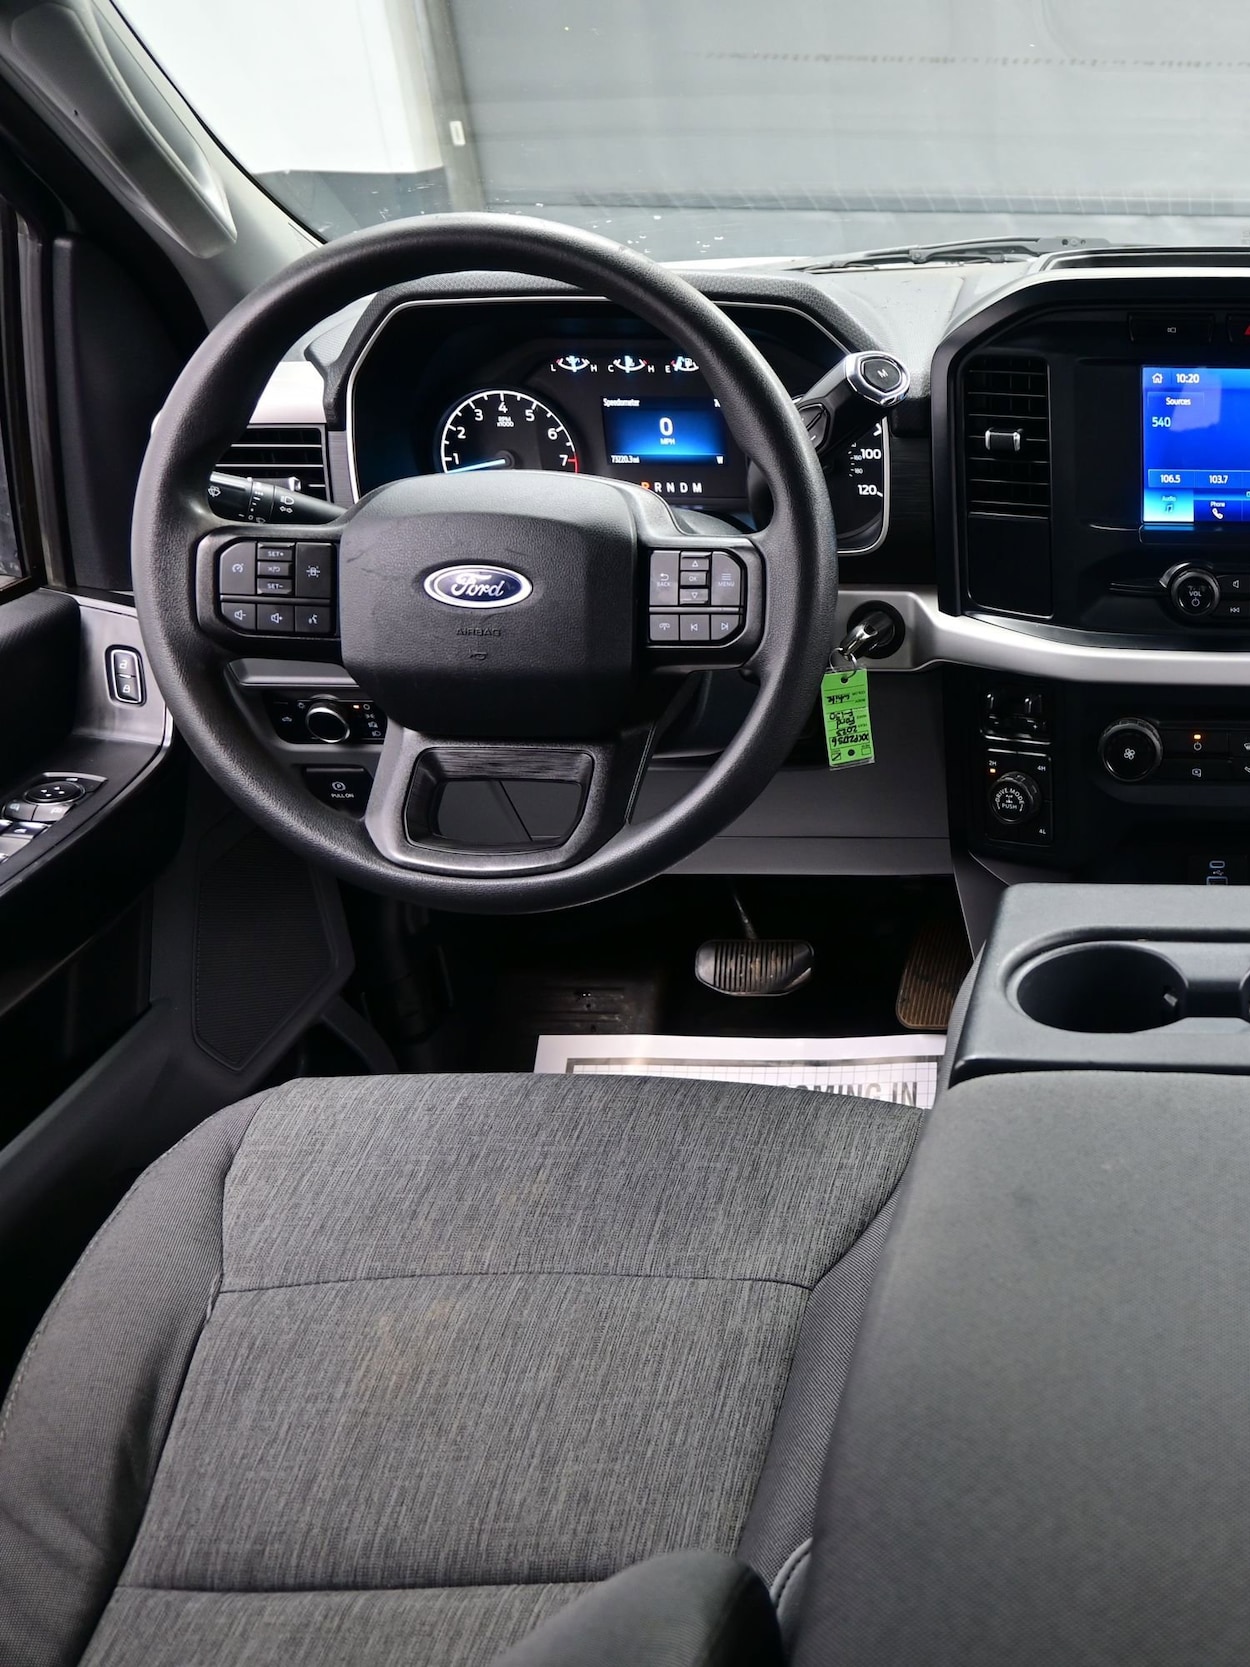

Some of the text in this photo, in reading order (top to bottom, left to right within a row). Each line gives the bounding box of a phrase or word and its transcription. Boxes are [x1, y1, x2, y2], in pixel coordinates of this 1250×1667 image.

[551, 364, 556, 372] L
[590, 364, 598, 372] H
[607, 364, 614, 372] C
[648, 364, 655, 373] H
[665, 365, 671, 373] E
[877, 368, 888, 378] M
[1176, 373, 1200, 384] 10:20
[1165, 397, 1191, 406] Sources
[498, 402, 508, 413] 4
[474, 409, 483, 421] 3
[525, 409, 535, 421] 5
[659, 417, 674, 436] 0
[1151, 416, 1171, 428] 540
[457, 427, 466, 439] 2
[547, 428, 558, 440] 6
[453, 453, 459, 465] 1
[860, 449, 881, 459] 100
[559, 455, 568, 467] 7
[1160, 474, 1181, 484] 106.5
[1209, 475, 1229, 484] 103.7
[654, 482, 662, 492] R
[666, 482, 675, 493] N
[680, 482, 688, 493] D
[692, 482, 702, 493] M
[858, 485, 877, 495] 120
[450, 572, 505, 597] Ford
[456, 627, 501, 637] AIRBAG
[995, 787, 1025, 805] DRIVE MODE
[892, 1082, 917, 1107] IN
